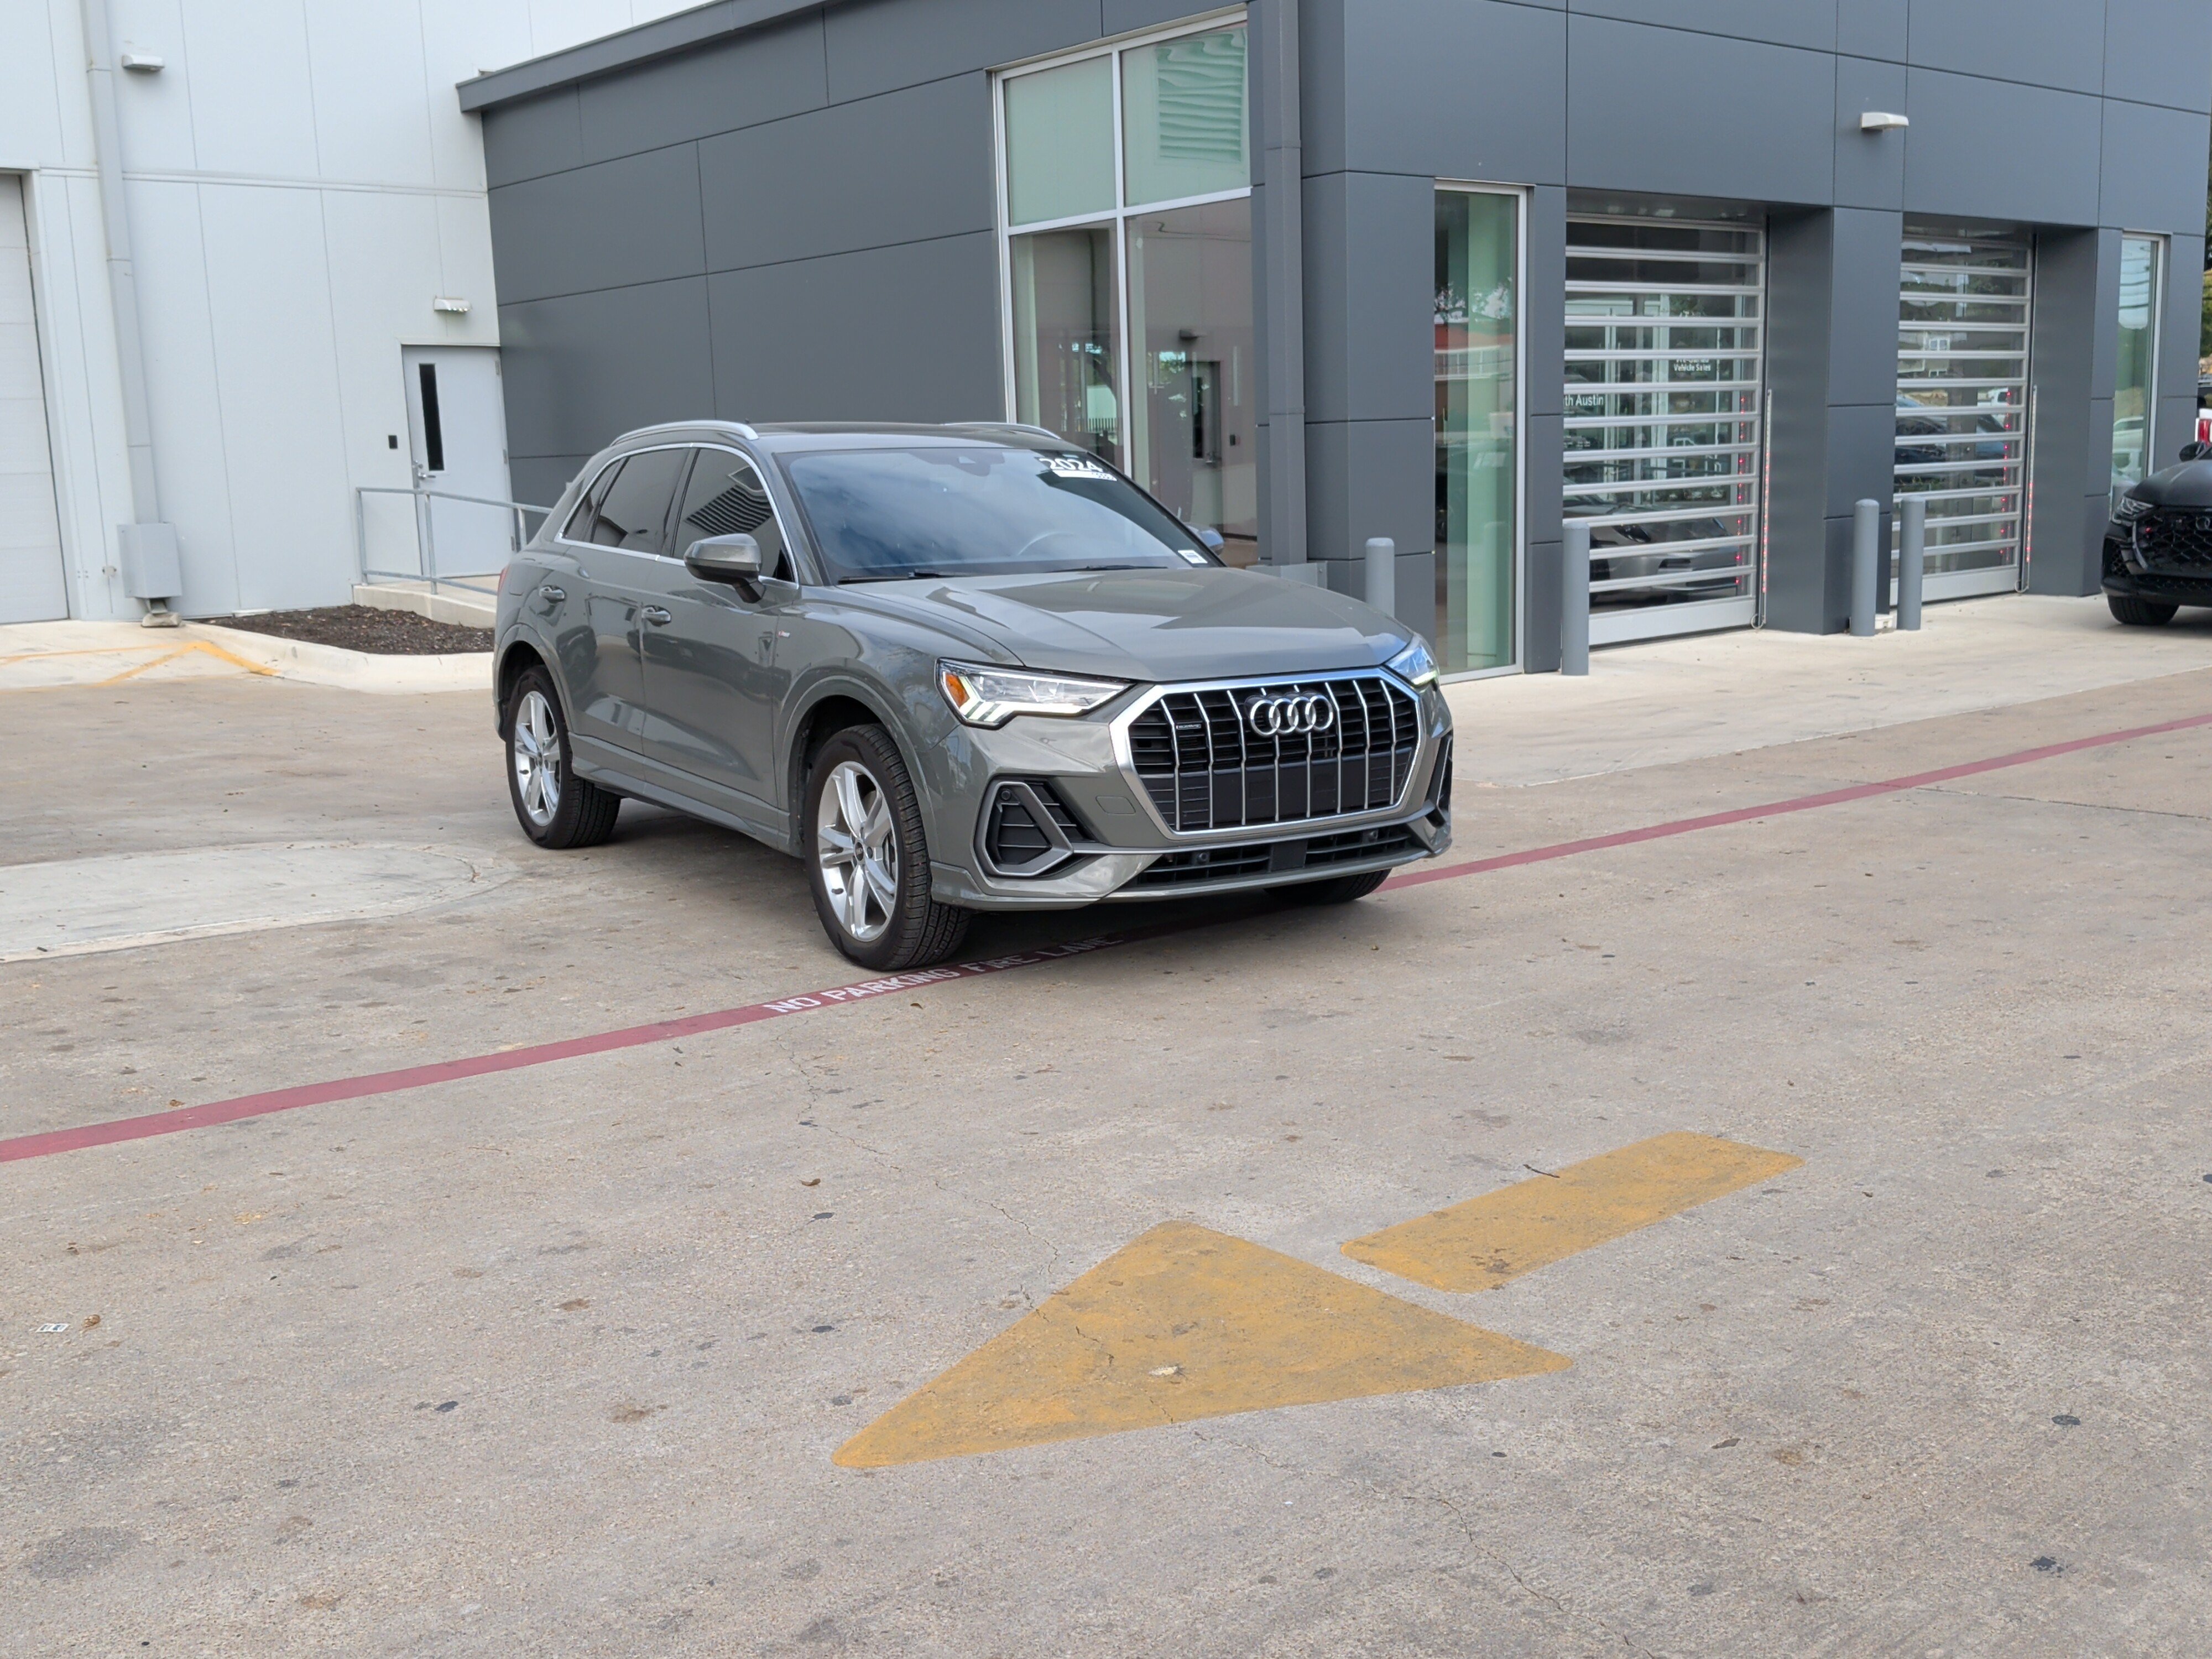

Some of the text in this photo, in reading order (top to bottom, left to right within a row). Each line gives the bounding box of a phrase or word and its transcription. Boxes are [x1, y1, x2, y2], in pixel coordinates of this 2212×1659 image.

[1575, 394, 1604, 406] Austin
[1039, 458, 1104, 473] 2024
[763, 997, 821, 1013] NO
[820, 968, 960, 1001] PARKING
[959, 954, 1041, 972] FIRE
